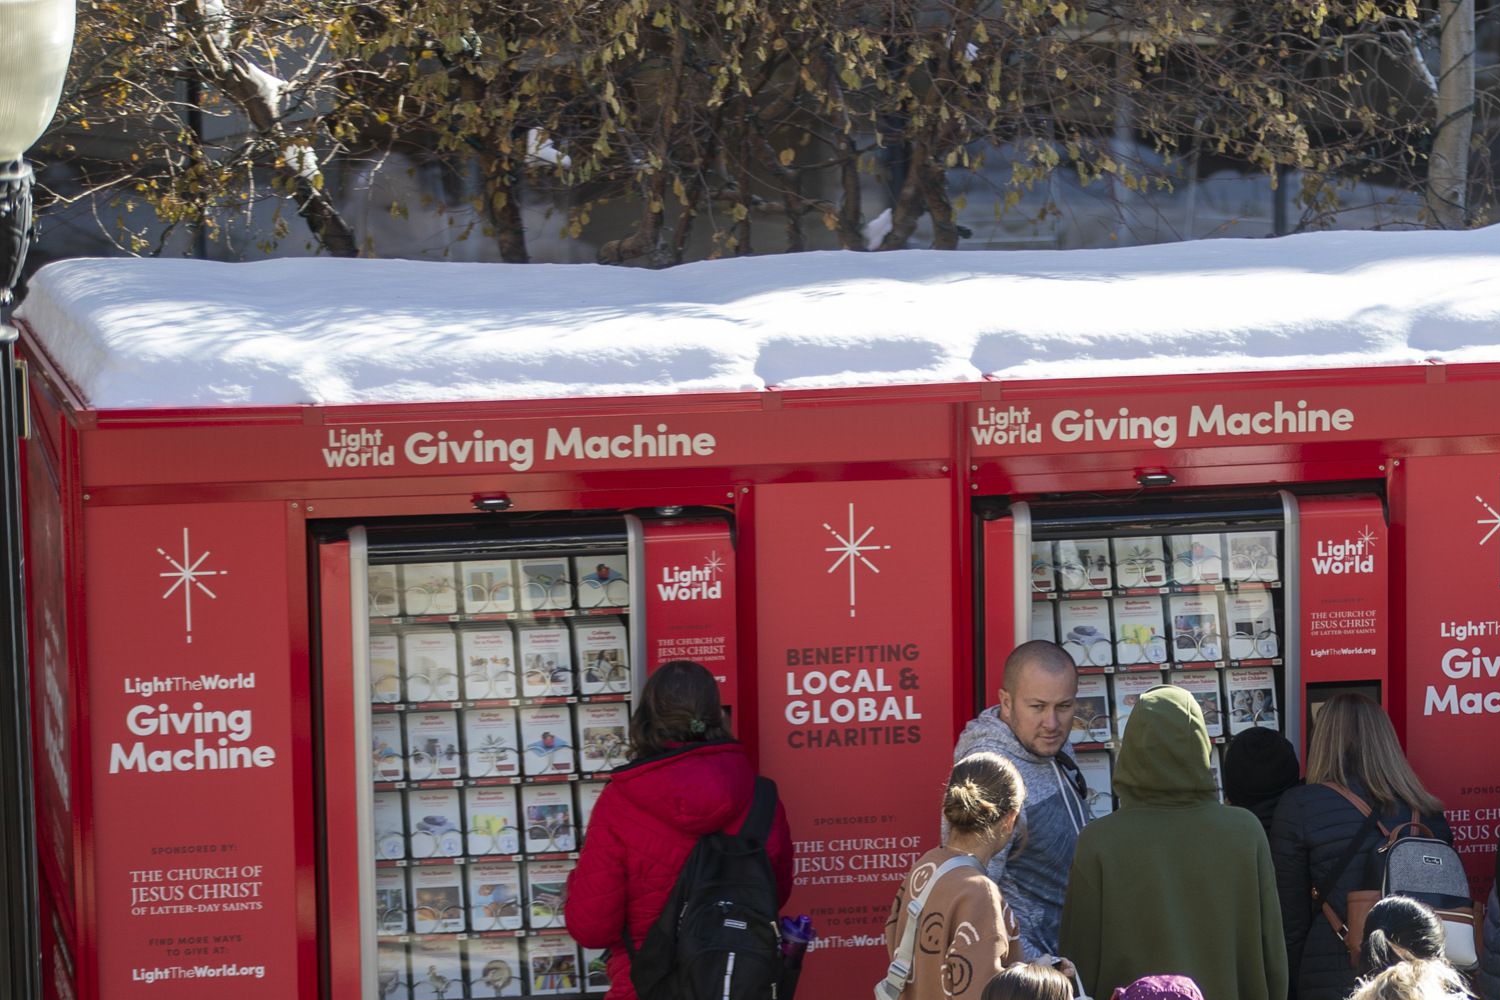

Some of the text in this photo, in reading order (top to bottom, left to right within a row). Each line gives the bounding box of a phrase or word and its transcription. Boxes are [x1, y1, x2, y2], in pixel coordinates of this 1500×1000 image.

[977, 407, 1031, 430] Light
[1051, 400, 1354, 448] Giving Machine
[328, 428, 384, 451] Light
[971, 423, 1042, 446] World
[322, 446, 395, 468] World
[404, 423, 717, 472] Giving Machine
[1317, 539, 1364, 561] Light
[663, 565, 712, 587] Light
[1311, 555, 1374, 575] World
[657, 580, 721, 601] World
[1311, 619, 1377, 630] JESUS CHRIST
[1328, 611, 1364, 619] CHURCH
[786, 643, 920, 667] BENEFITING
[1311, 647, 1377, 658] LightTheWorld.org
[124, 672, 255, 697] LightTheWorld
[786, 667, 920, 696] LOCAL &
[784, 695, 922, 725] GLOBAL
[126, 702, 252, 742] Giving
[786, 725, 922, 750] CHARITIES
[109, 737, 276, 774] Machine
[813, 817, 878, 826] SPONSORED
[1449, 825, 1489, 840] ESUS
[152, 844, 217, 856] SPONSORED
[792, 836, 921, 853] THE CHURCH OF
[1458, 843, 1498, 853] LATTER
[130, 865, 263, 883] THE CHURCH OF
[792, 852, 921, 878] JESUS CHRIST
[793, 871, 910, 886] OF LATTER-DAY SAIN
[131, 882, 262, 906] JESUS CHRIST
[131, 901, 263, 916] OF LATTER-DAY SAINTS
[870, 904, 892, 914] WAY
[806, 935, 887, 952] ghtTheWorl
[132, 964, 265, 984] LightTheWorld.org
